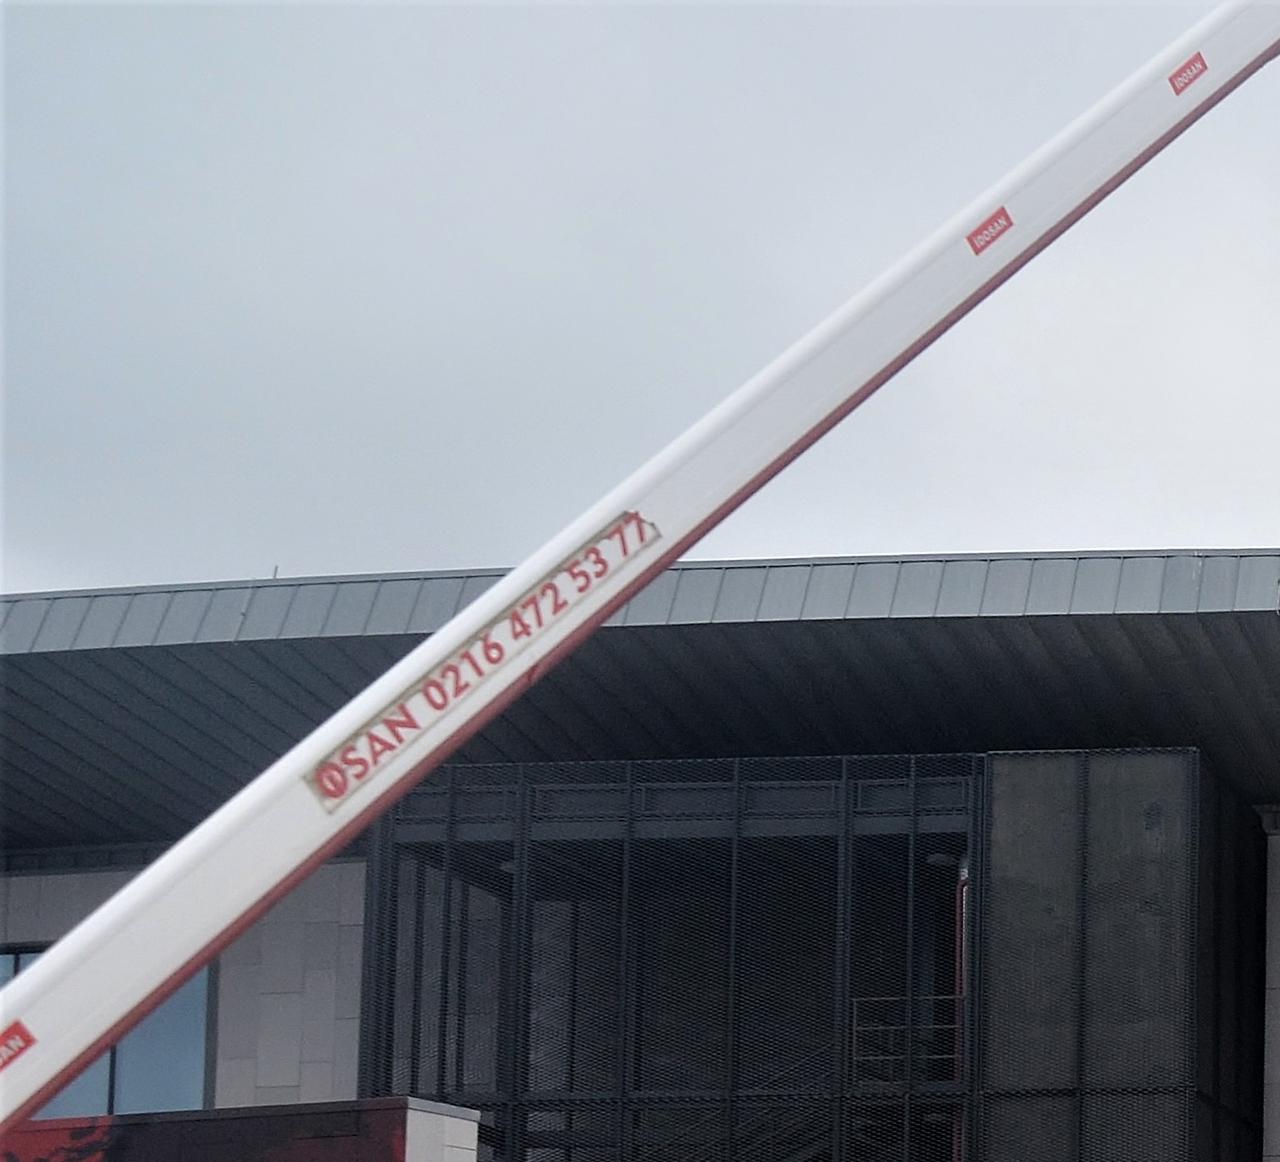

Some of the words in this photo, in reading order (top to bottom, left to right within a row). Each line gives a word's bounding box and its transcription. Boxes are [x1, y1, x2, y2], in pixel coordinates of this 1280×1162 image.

[422, 632, 505, 711] 0216
[509, 582, 569, 640] 472
[567, 546, 608, 594] 53
[608, 511, 645, 557] 77
